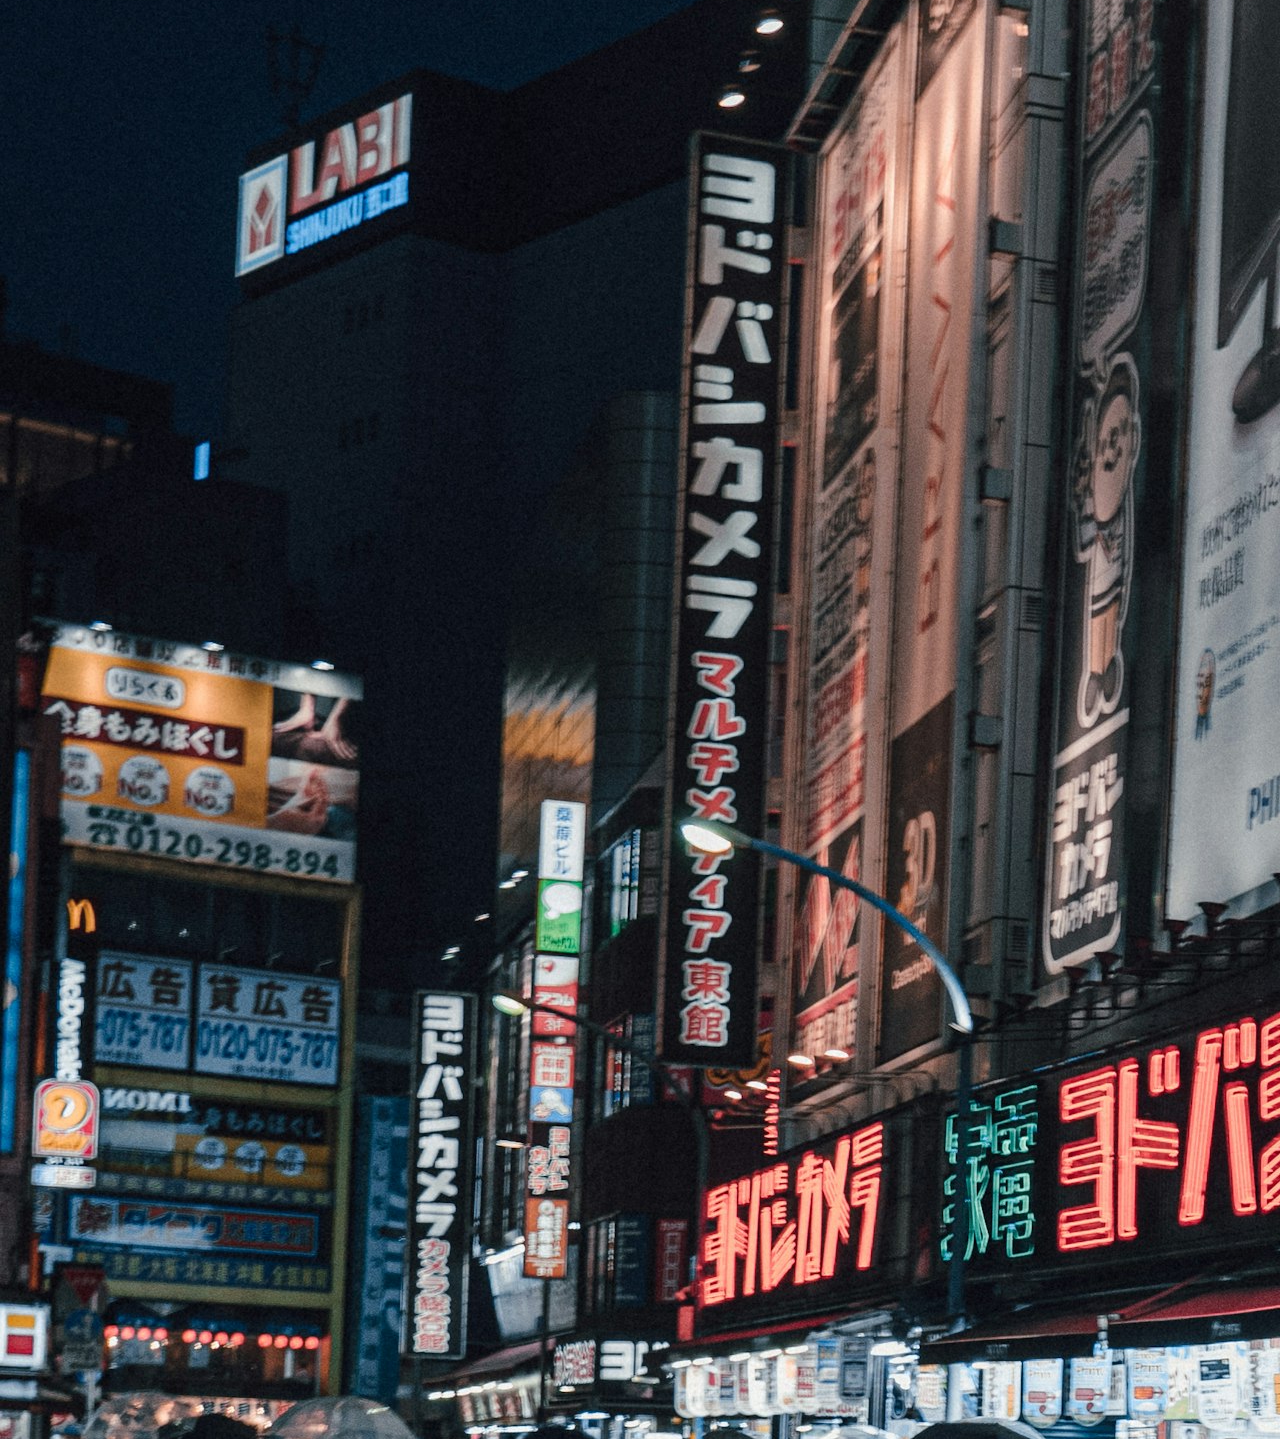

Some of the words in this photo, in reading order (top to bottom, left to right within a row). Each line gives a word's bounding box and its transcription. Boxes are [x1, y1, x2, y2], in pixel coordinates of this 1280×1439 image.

[289, 93, 412, 216] LABI
[684, 153, 776, 640] ヨドバシカメラ
[44, 699, 239, 761] 全身もみほぐし
[1053, 752, 1124, 843] ヨドバシ
[125, 825, 340, 879] 0120-298-894
[1058, 819, 1113, 900] カメラ
[416, 994, 465, 1238] ヨドバシカメラ
[703, 1121, 893, 1308] ヨドバシカメラ
